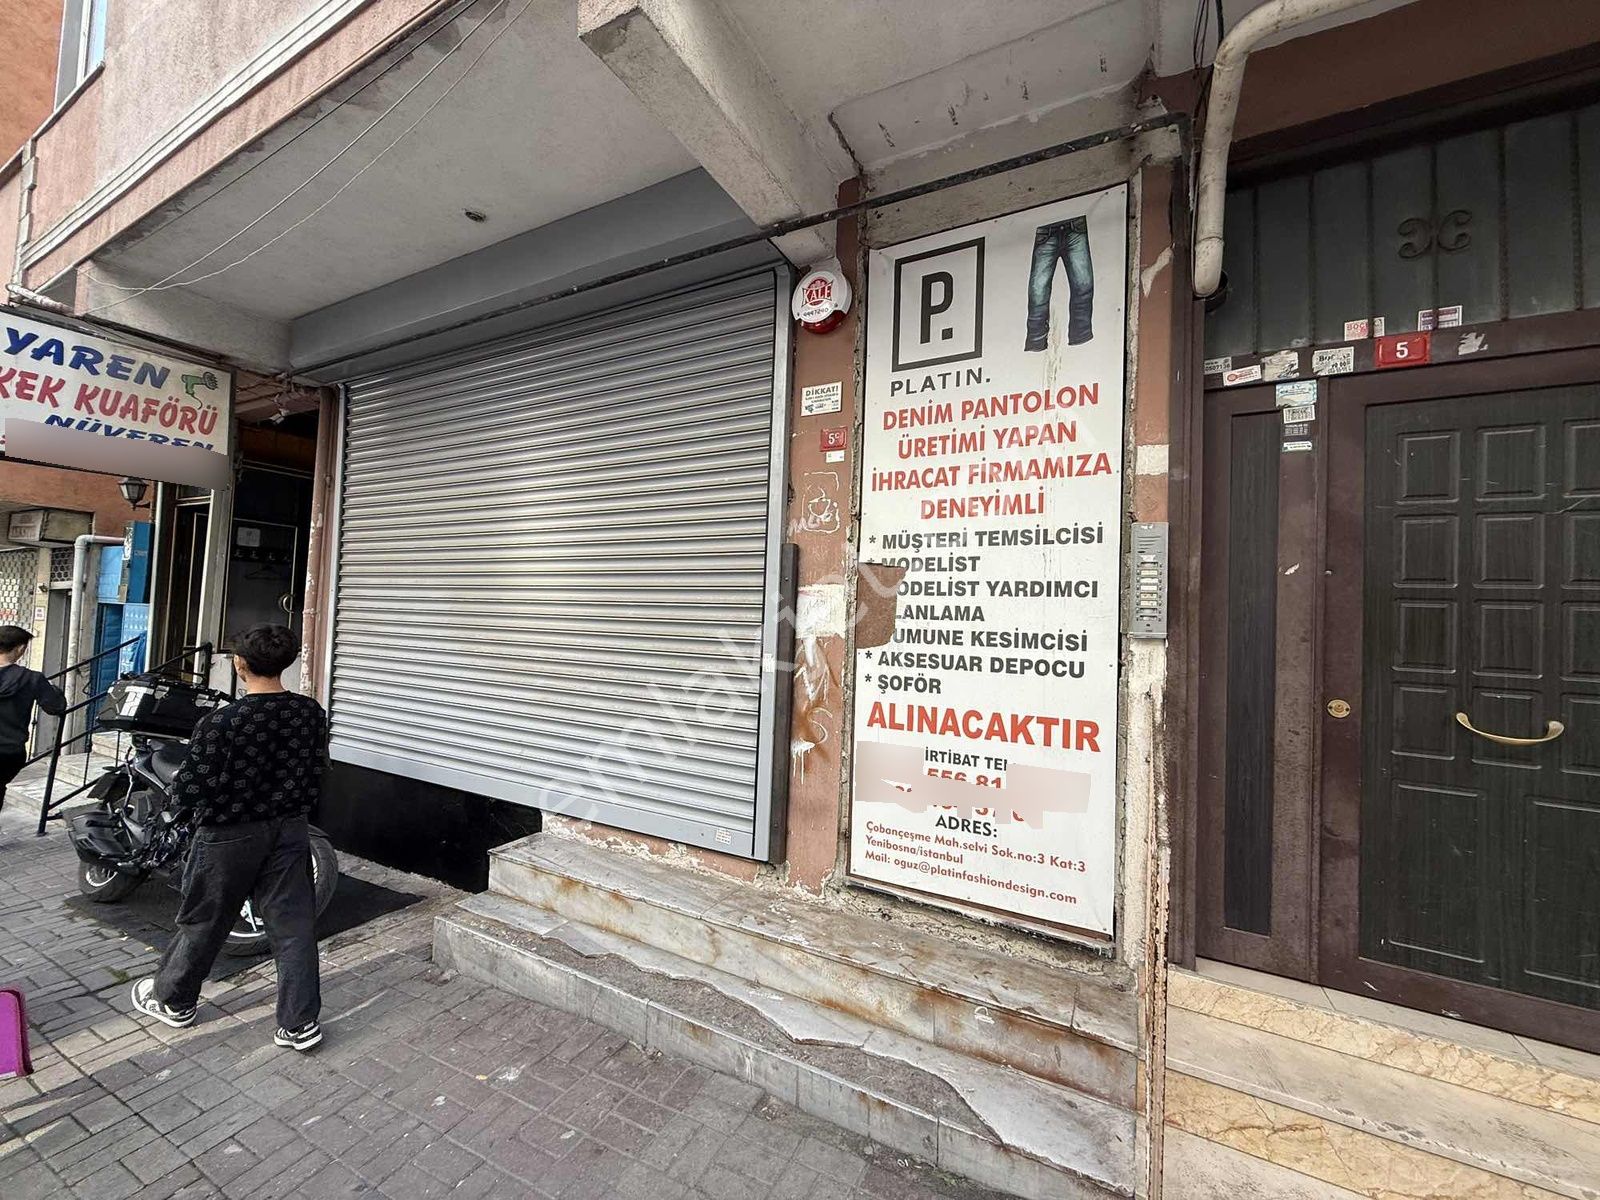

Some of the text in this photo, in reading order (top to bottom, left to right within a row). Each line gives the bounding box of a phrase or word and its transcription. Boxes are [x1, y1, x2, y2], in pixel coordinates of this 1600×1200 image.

[802, 283, 833, 307] KALE
[4, 327, 171, 389] YAREN
[1395, 341, 1409, 359] 5
[805, 385, 839, 397] DİKKAT!
[890, 367, 991, 397] PLATIN.
[73, 383, 218, 436] KUAFÖRÜ
[883, 383, 1099, 430] DENİM PANTOLON
[898, 420, 1077, 459] ÜRETİMİ YAPAN
[872, 452, 1112, 492] İHRACAT FİRMAMIZA
[920, 486, 1044, 520] DENEYİMLİ
[882, 521, 1104, 553] MÜŞTERİ TEMSİLCİSİ
[896, 576, 1098, 598] ODELİST YARDIMCI
[892, 627, 1088, 652] UMUNE KESİMCİSİ
[878, 651, 1085, 679] AKSESUAR DEPOCU
[877, 671, 942, 694] ŞOFÖR
[867, 701, 1101, 753] ALINACAKTIR
[925, 746, 980, 768] İRTİBAT
[935, 815, 998, 838] ADRES:
[865, 820, 932, 843] Çobançeşme
[991, 844, 1045, 864] Sok.no:3
[1049, 855, 1086, 873] Kat:3
[865, 836, 963, 864] Yenibosna/istanbul
[864, 850, 1077, 904] Mail: oguz@platinfashiondesign.com
